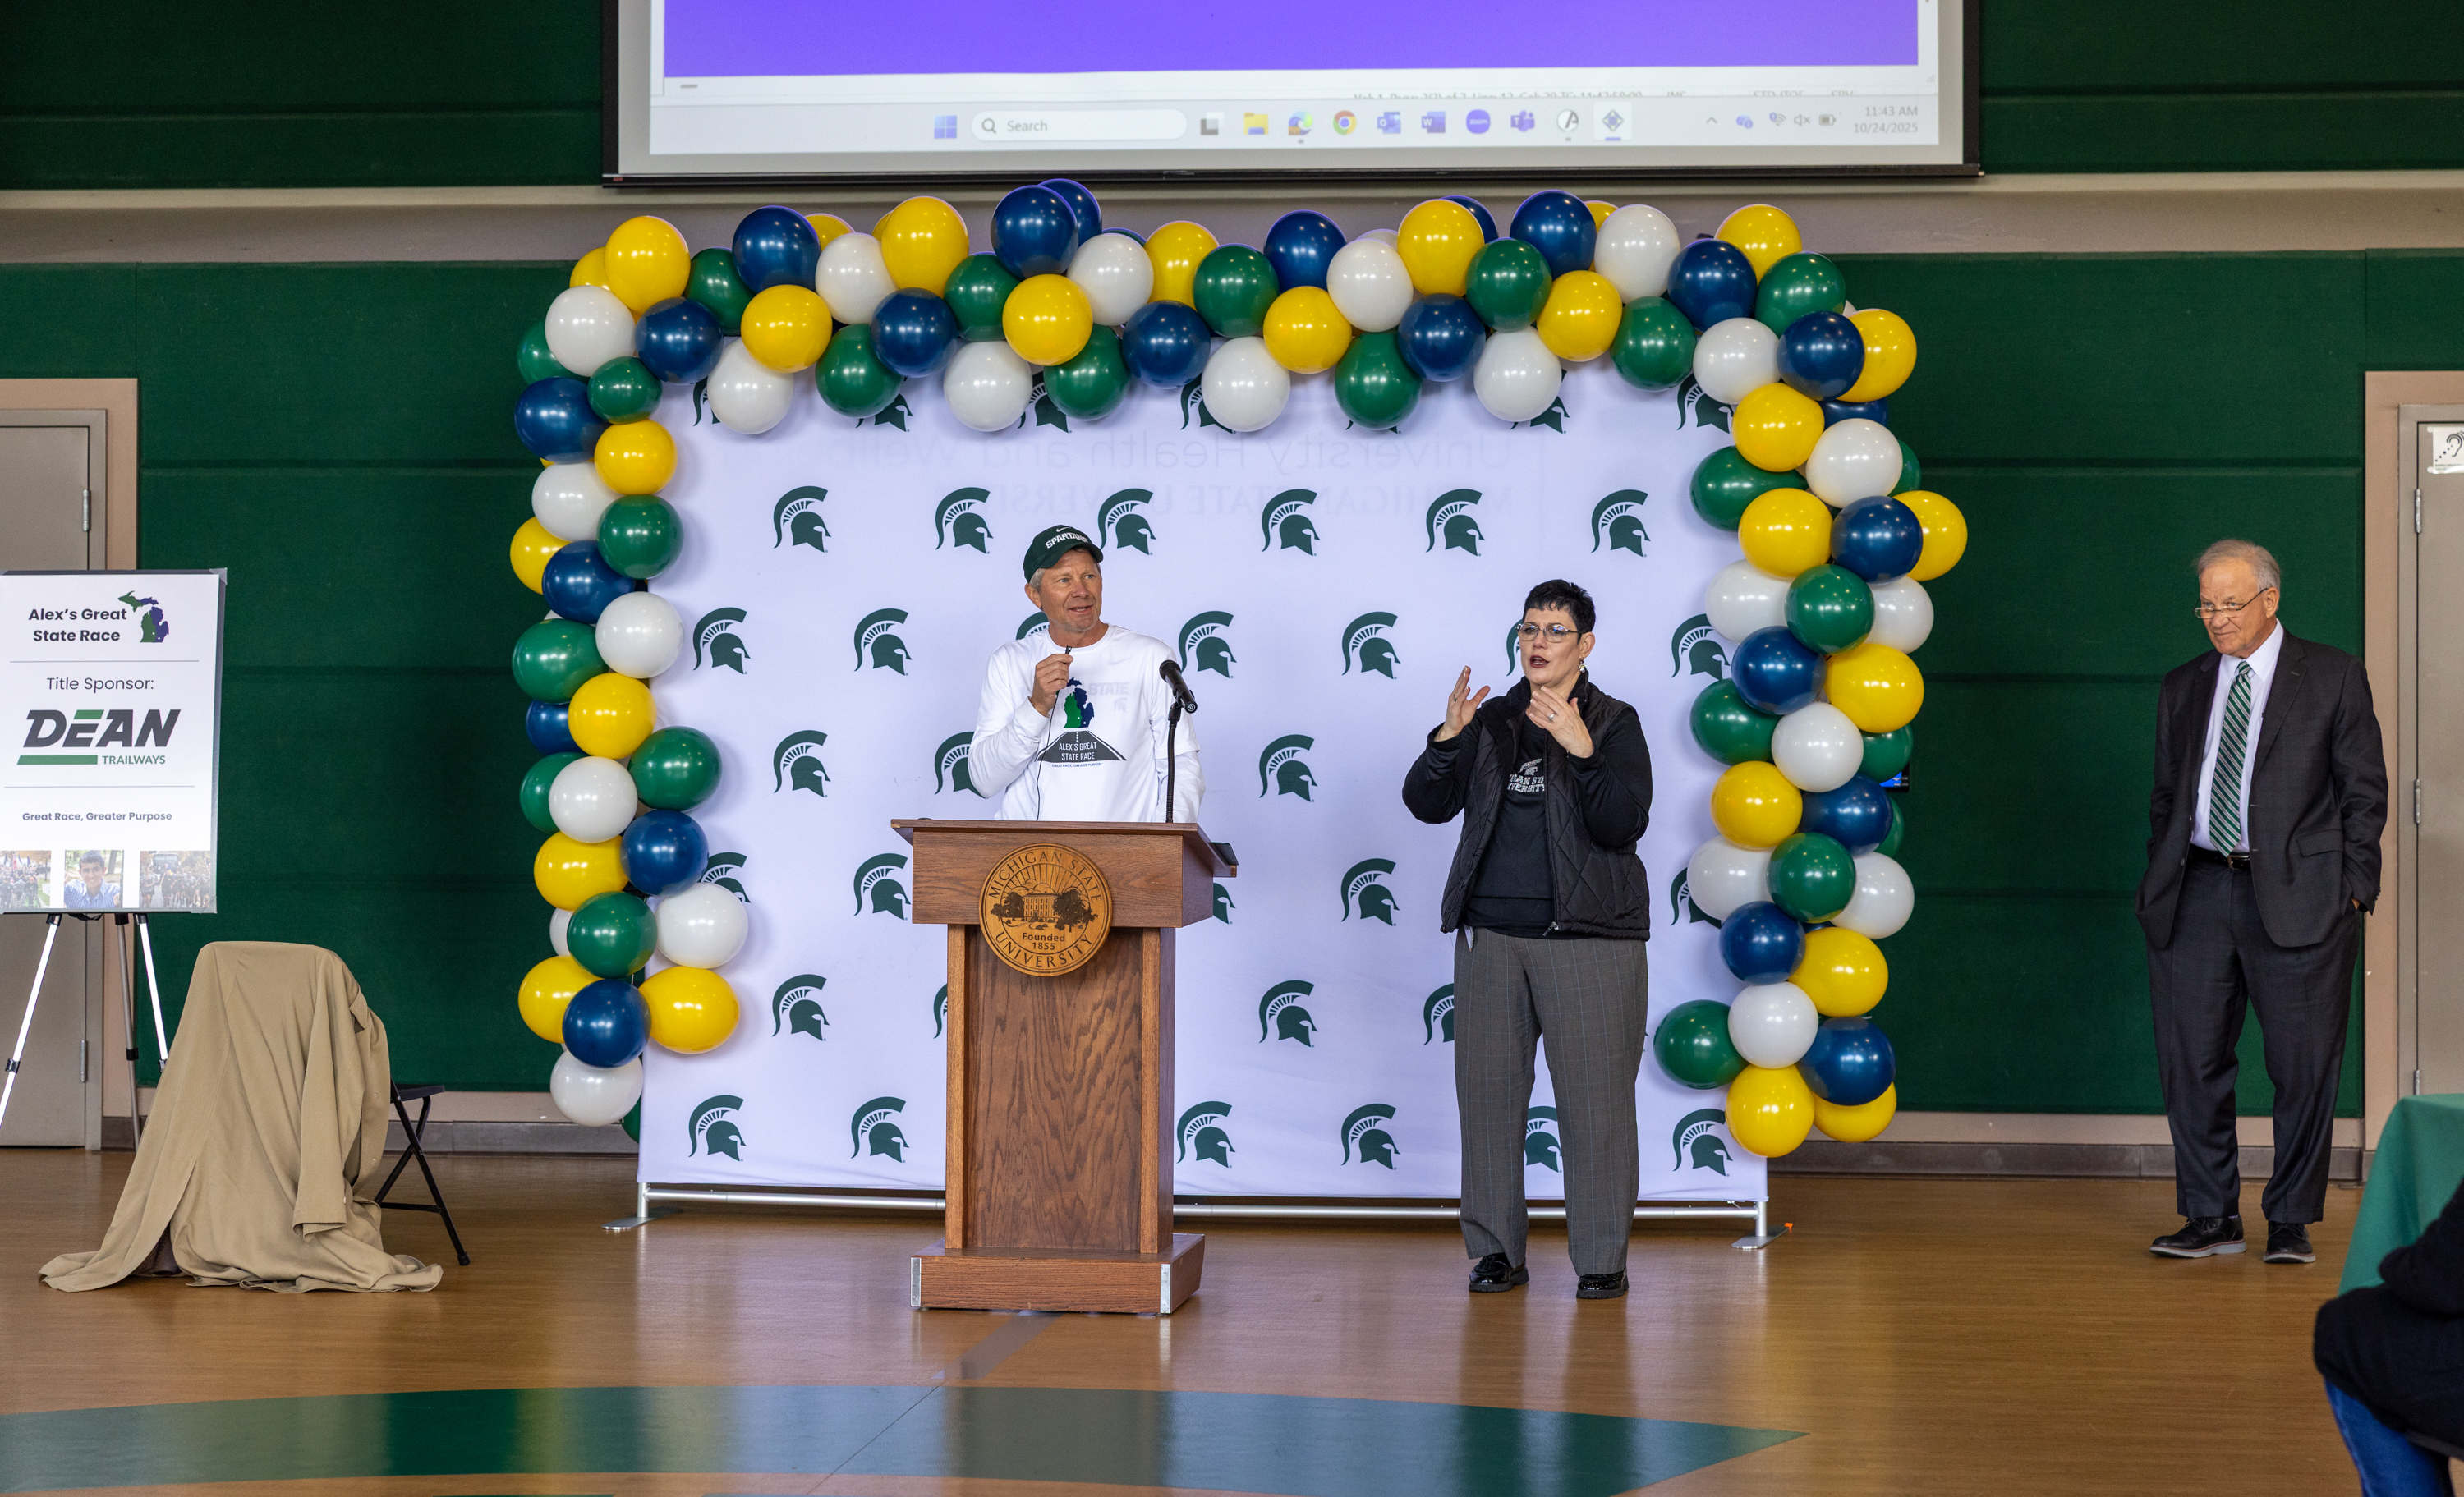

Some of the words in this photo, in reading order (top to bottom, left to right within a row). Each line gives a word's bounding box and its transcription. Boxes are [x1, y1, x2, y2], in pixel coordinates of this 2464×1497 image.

[1865, 105, 1895, 116] 11:43
[1898, 105, 1918, 116] AM
[1007, 120, 1048, 131] Search
[1855, 122, 1919, 134] 10/24/2025
[1045, 532, 1088, 549] SPARTANS
[28, 608, 77, 621] Alex’s
[81, 608, 127, 621] Great
[33, 630, 76, 641] State
[80, 630, 120, 641] Race
[47, 677, 79, 690] Title
[84, 677, 154, 693] Sponsor:
[23, 709, 181, 747] DEAN
[1059, 742, 1078, 751] ALEX'S
[1079, 742, 1097, 751] GREAT
[102, 755, 166, 765] TRAILWAYS
[1061, 752, 1079, 760] STATE
[1080, 752, 1095, 760] RACE
[22, 812, 53, 821] Great
[54, 812, 84, 821] Race,
[85, 812, 126, 820] Greater
[129, 812, 172, 822] Purpose
[988, 851, 1062, 899] MICHIGAN
[1068, 859, 1102, 903] STATE
[1022, 932, 1065, 942] Founded
[995, 931, 1093, 968] UNIVERSITY
[1032, 942, 1055, 950] 1855
